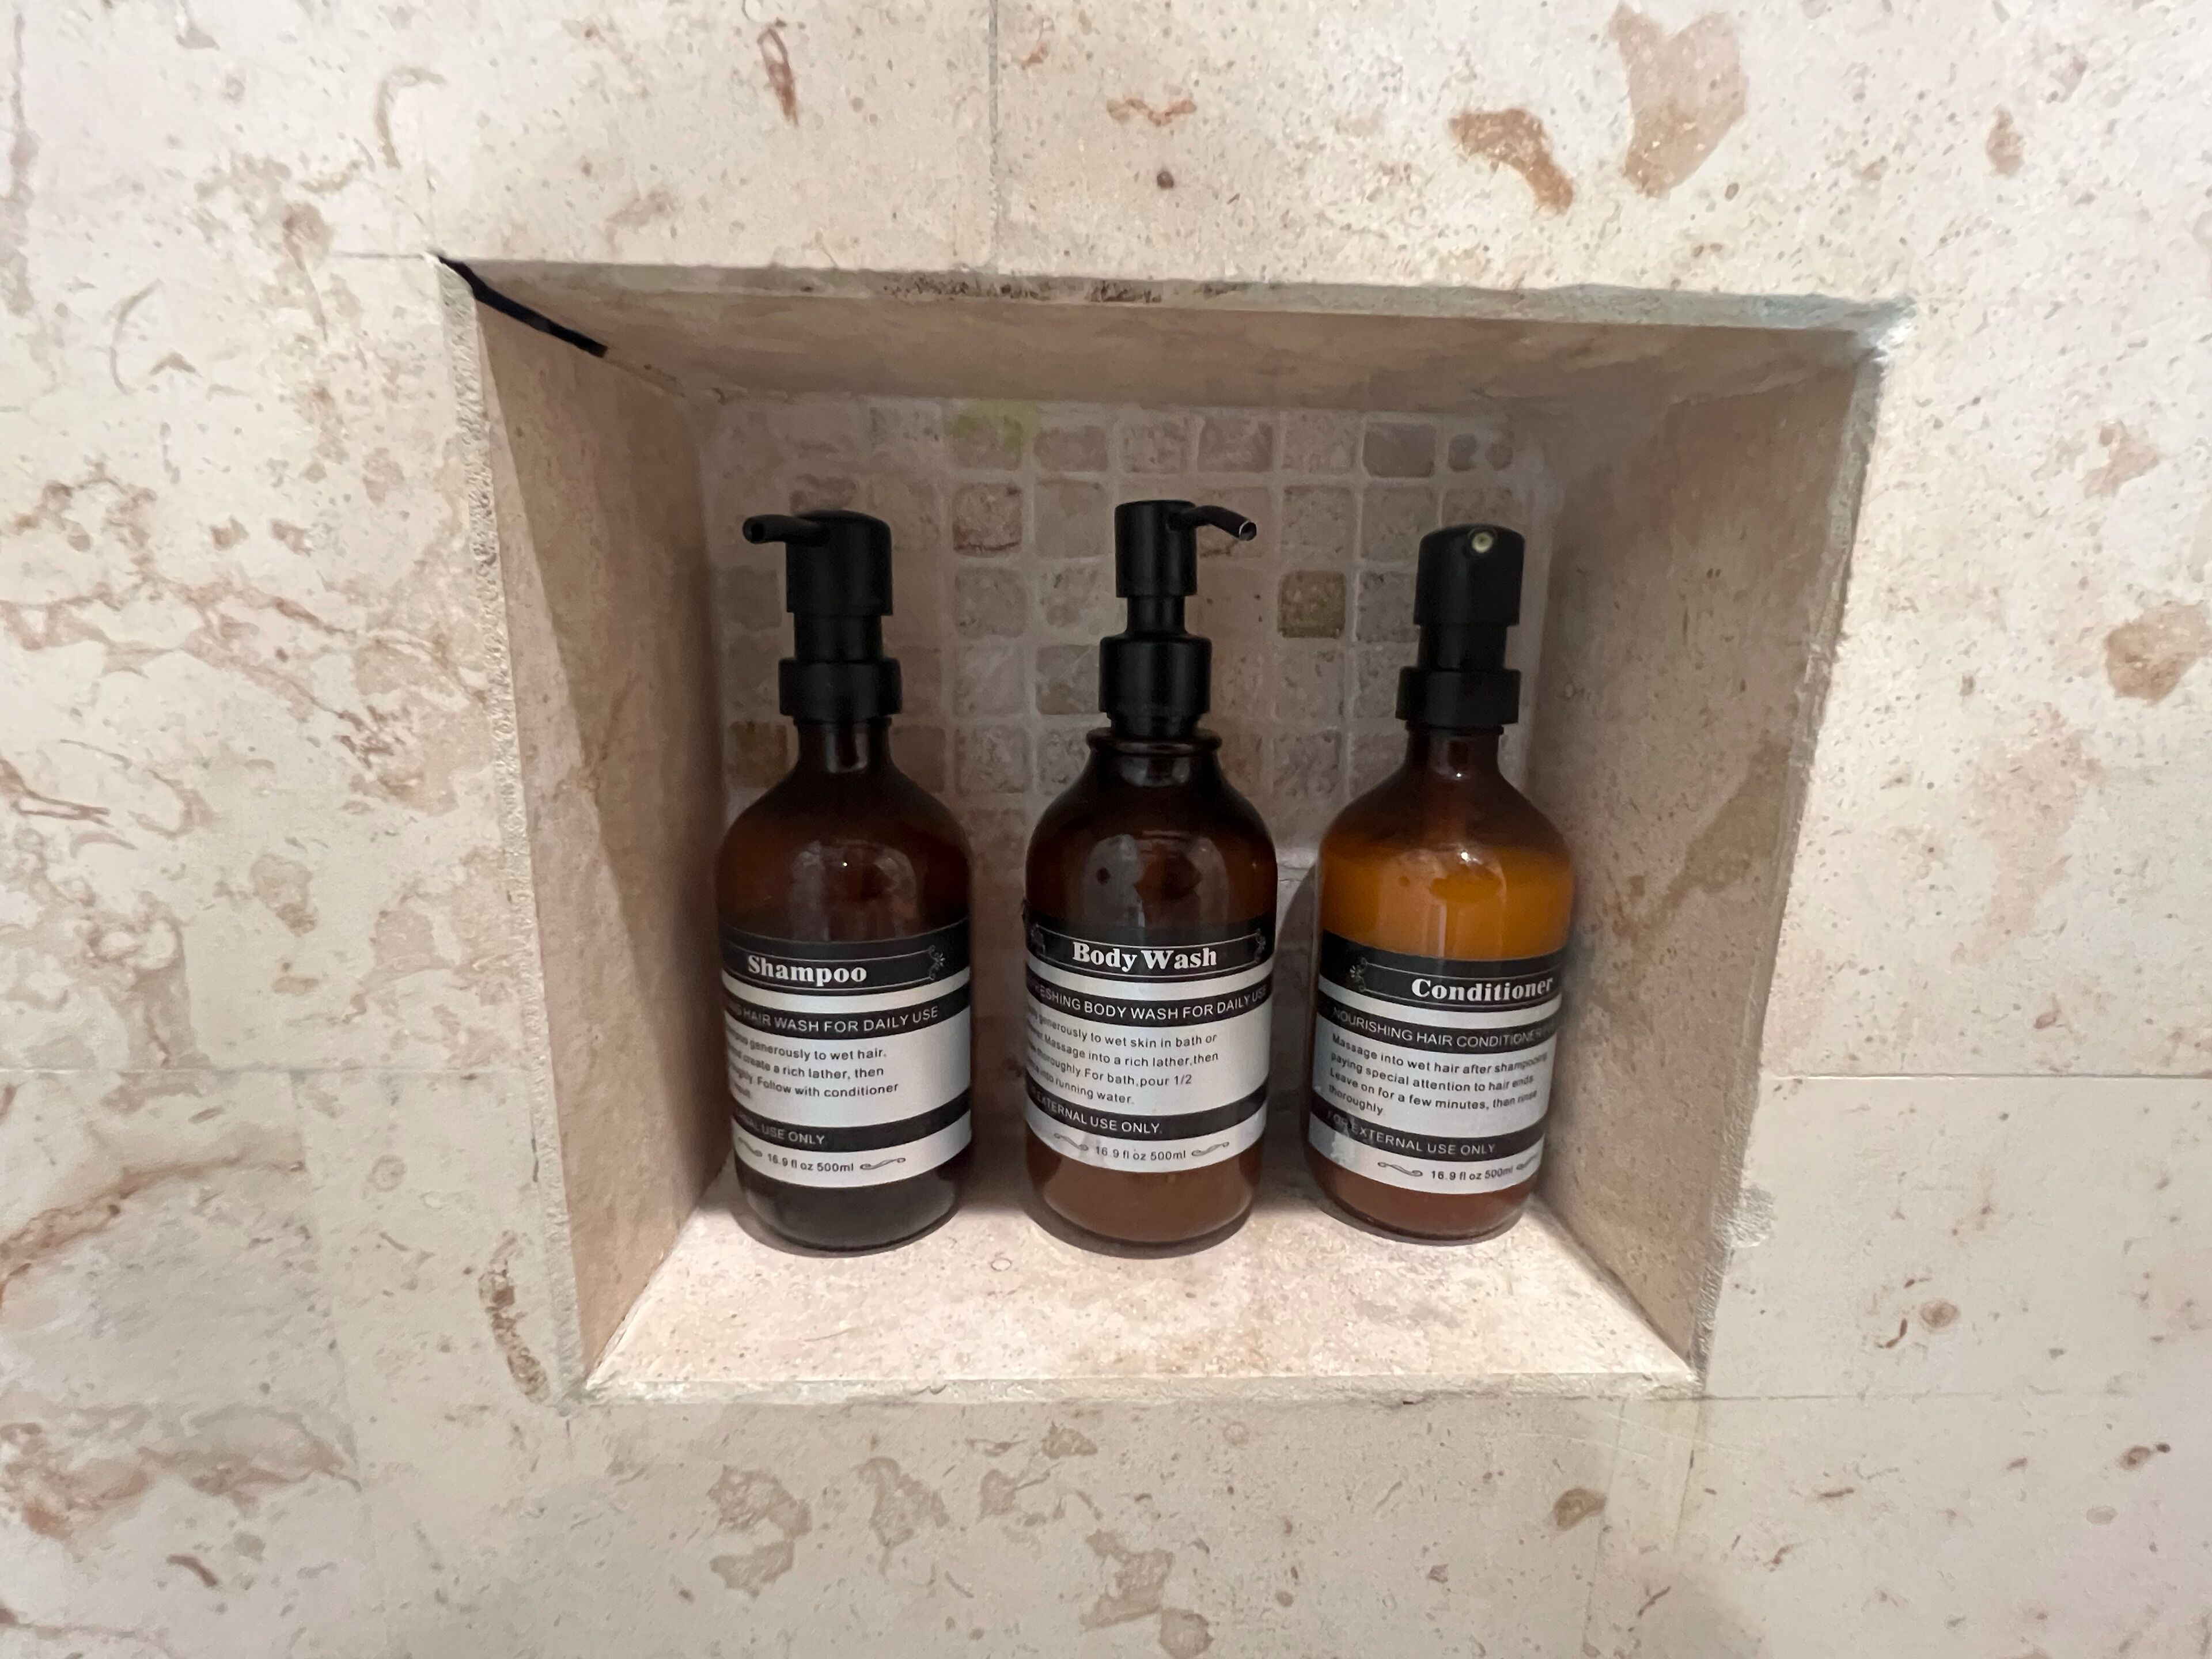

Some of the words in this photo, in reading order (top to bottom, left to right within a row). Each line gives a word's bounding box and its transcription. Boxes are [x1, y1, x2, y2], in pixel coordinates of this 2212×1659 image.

[1073, 942, 1137, 972] Body
[1141, 948, 1217, 970] Wash
[748, 954, 867, 987] Shampoo
[1411, 978, 1553, 1002] Conditioner
[1085, 1001, 1126, 1018] BODY
[1131, 1007, 1179, 1020] WASH
[1183, 1004, 1213, 1018] FOR
[1217, 995, 1251, 1014] DAILY
[744, 1007, 771, 1027] HAIR
[774, 1017, 819, 1032] WASH
[824, 1021, 858, 1033] FOR
[864, 1014, 908, 1031] DAILY
[912, 1006, 938, 1024] USE
[1331, 1006, 1413, 1041] NOURISHING
[1416, 1032, 1452, 1046] HAIR
[750, 1040, 810, 1062] generously
[815, 1051, 827, 1060] to
[830, 1050, 854, 1060] wet
[1044, 1033, 1085, 1059] Massage
[1089, 1051, 1110, 1063] into
[1114, 1057, 1121, 1065] a
[1125, 1056, 1149, 1067] rich
[1091, 1032, 1101, 1043] to
[1105, 1037, 1127, 1047] wet
[1130, 1037, 1156, 1048] skin
[1161, 1037, 1171, 1048] in
[1176, 1035, 1202, 1047] bath
[1206, 1034, 1217, 1043] or
[1332, 1033, 1377, 1060] Massage
[1381, 1053, 1404, 1066] into
[1407, 1060, 1430, 1072] wet
[1434, 1062, 1460, 1074] hair
[1463, 1064, 1492, 1074] after
[774, 1065, 780, 1074] a
[783, 1067, 805, 1077] rich
[855, 1067, 884, 1078] then
[1174, 1074, 1192, 1086] 1/2
[1331, 1051, 1363, 1075] paying
[1366, 1066, 1409, 1085] special
[1412, 1079, 1471, 1092] attention
[1474, 1083, 1486, 1092] to
[1488, 1080, 1510, 1091] hair
[757, 1076, 791, 1094] Follow
[795, 1086, 820, 1097] with
[824, 1084, 899, 1098] conditioner
[1056, 1078, 1093, 1100] running
[1330, 1067, 1358, 1089] Leave
[1361, 1084, 1374, 1094] on
[1378, 1087, 1395, 1100] for
[1398, 1093, 1405, 1103] a
[1410, 1094, 1431, 1107] few
[1493, 1097, 1516, 1108] then
[762, 1124, 785, 1140] USE
[788, 1131, 825, 1145] ONLY
[1090, 1117, 1118, 1131] USE
[1351, 1123, 1423, 1152] EXTERNAL
[1427, 1142, 1457, 1155] USE
[1460, 1143, 1496, 1156] ONLY
[791, 1159, 798, 1169] fl
[800, 1162, 814, 1171] oz
[817, 1162, 854, 1172] 500ml
[1123, 1150, 1129, 1159] fl
[1132, 1152, 1146, 1161] oz
[1150, 1150, 1186, 1161] 500ml
[1459, 1172, 1466, 1180] fl
[1484, 1165, 1514, 1179] 500ml
